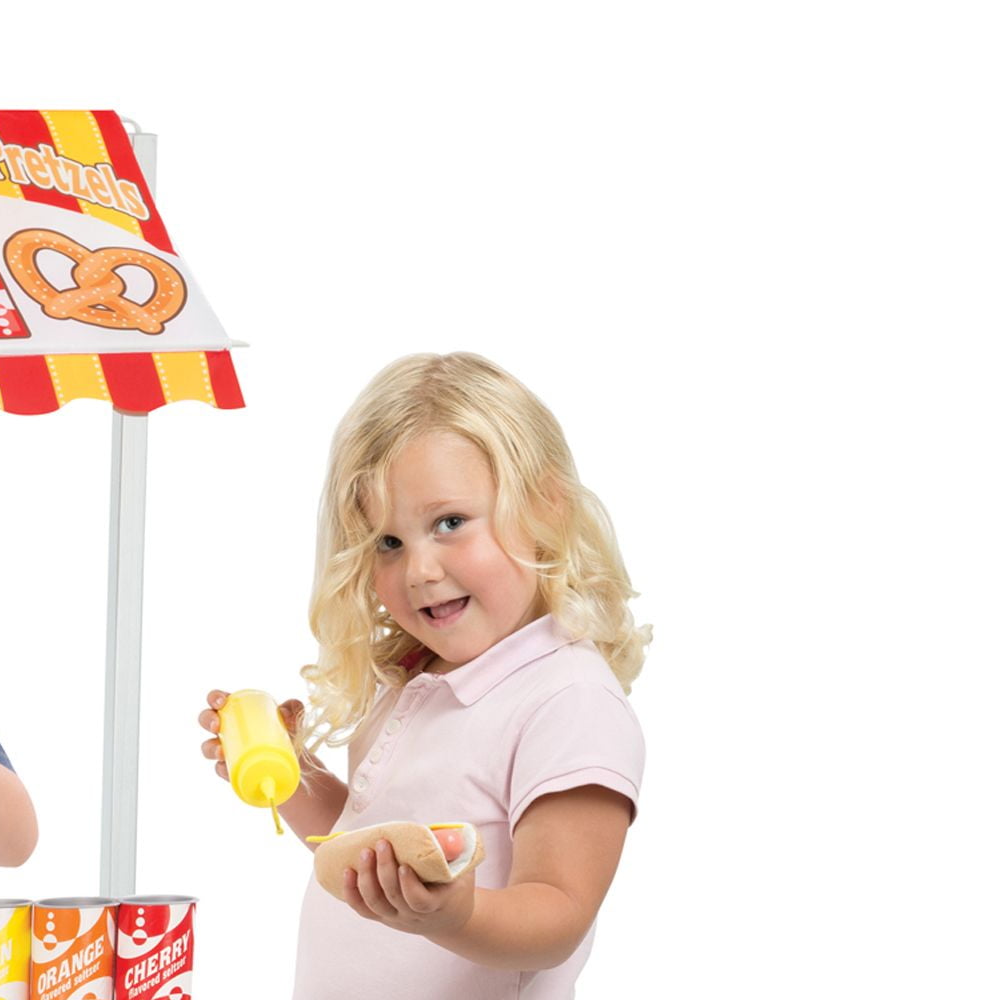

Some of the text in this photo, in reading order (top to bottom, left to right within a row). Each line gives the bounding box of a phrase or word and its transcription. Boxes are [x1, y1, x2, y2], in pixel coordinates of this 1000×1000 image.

[37, 935, 105, 995] ORANGE
[74, 961, 101, 986] seltzer
[124, 929, 191, 990] CHERRY
[128, 956, 187, 1000] flavored seltzer
